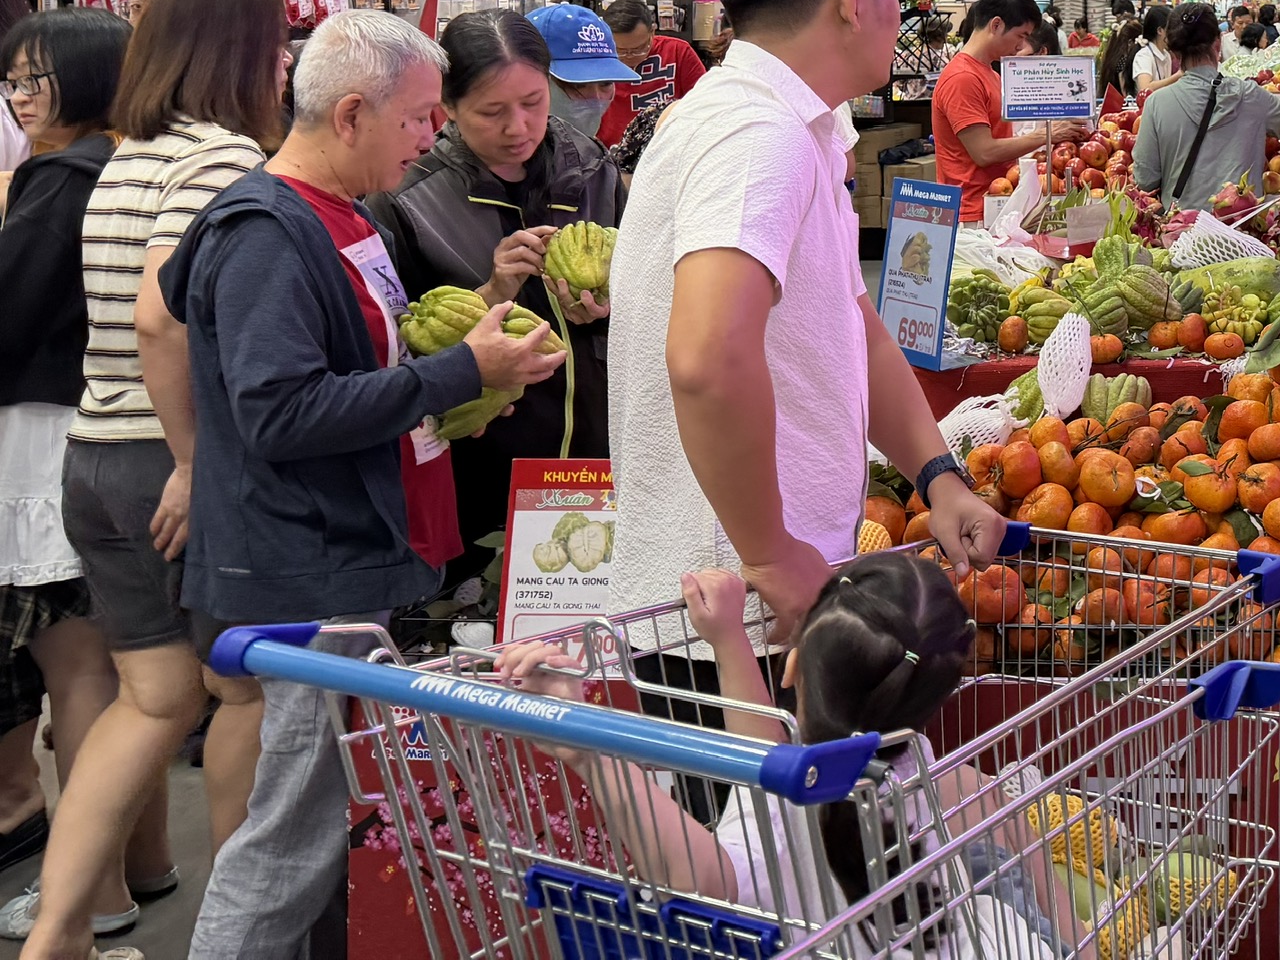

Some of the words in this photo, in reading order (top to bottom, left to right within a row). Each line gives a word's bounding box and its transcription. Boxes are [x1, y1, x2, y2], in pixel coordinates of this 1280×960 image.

[1056, 67, 1070, 75] Sinh
[1071, 68, 1084, 76] Học
[543, 466, 597, 483] KHUYẾN
[536, 489, 594, 509] Xuân
[516, 577, 543, 585] MANG
[546, 577, 565, 585] CAU
[568, 577, 579, 585] TA
[582, 577, 609, 585] GIONG
[515, 591, 553, 601] (371752)
[515, 602, 535, 610] MANG
[536, 602, 551, 610] CAU
[553, 602, 561, 610] TA
[563, 602, 583, 610] GIONG
[585, 602, 601, 610] THAI
